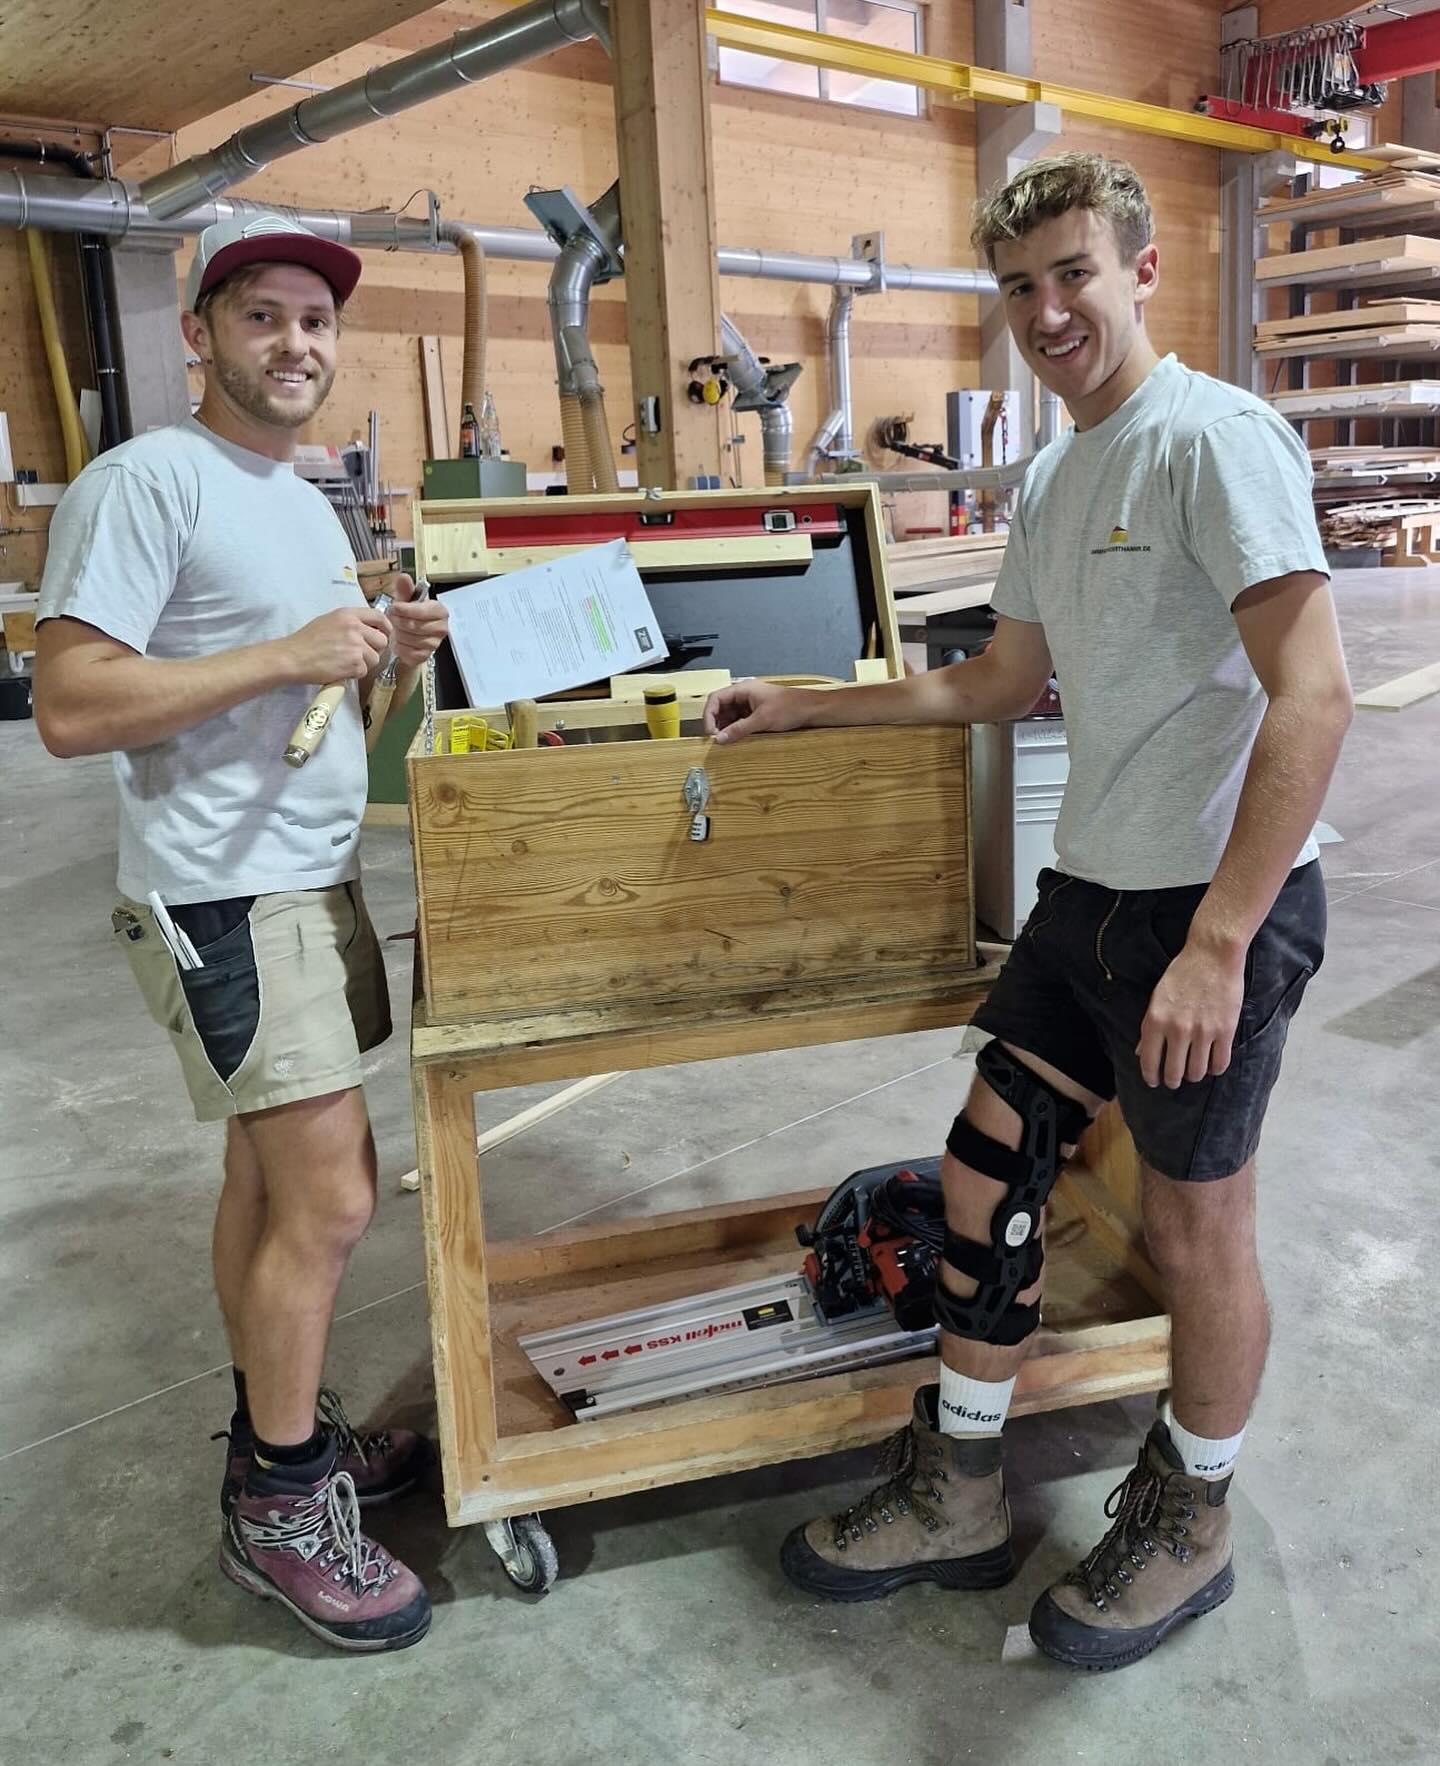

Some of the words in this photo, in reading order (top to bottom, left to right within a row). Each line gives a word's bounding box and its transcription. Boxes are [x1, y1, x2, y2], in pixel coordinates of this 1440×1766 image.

[686, 1320, 742, 1340] mafell
[647, 1335, 681, 1349] KSS
[942, 1400, 1001, 1422] adidas
